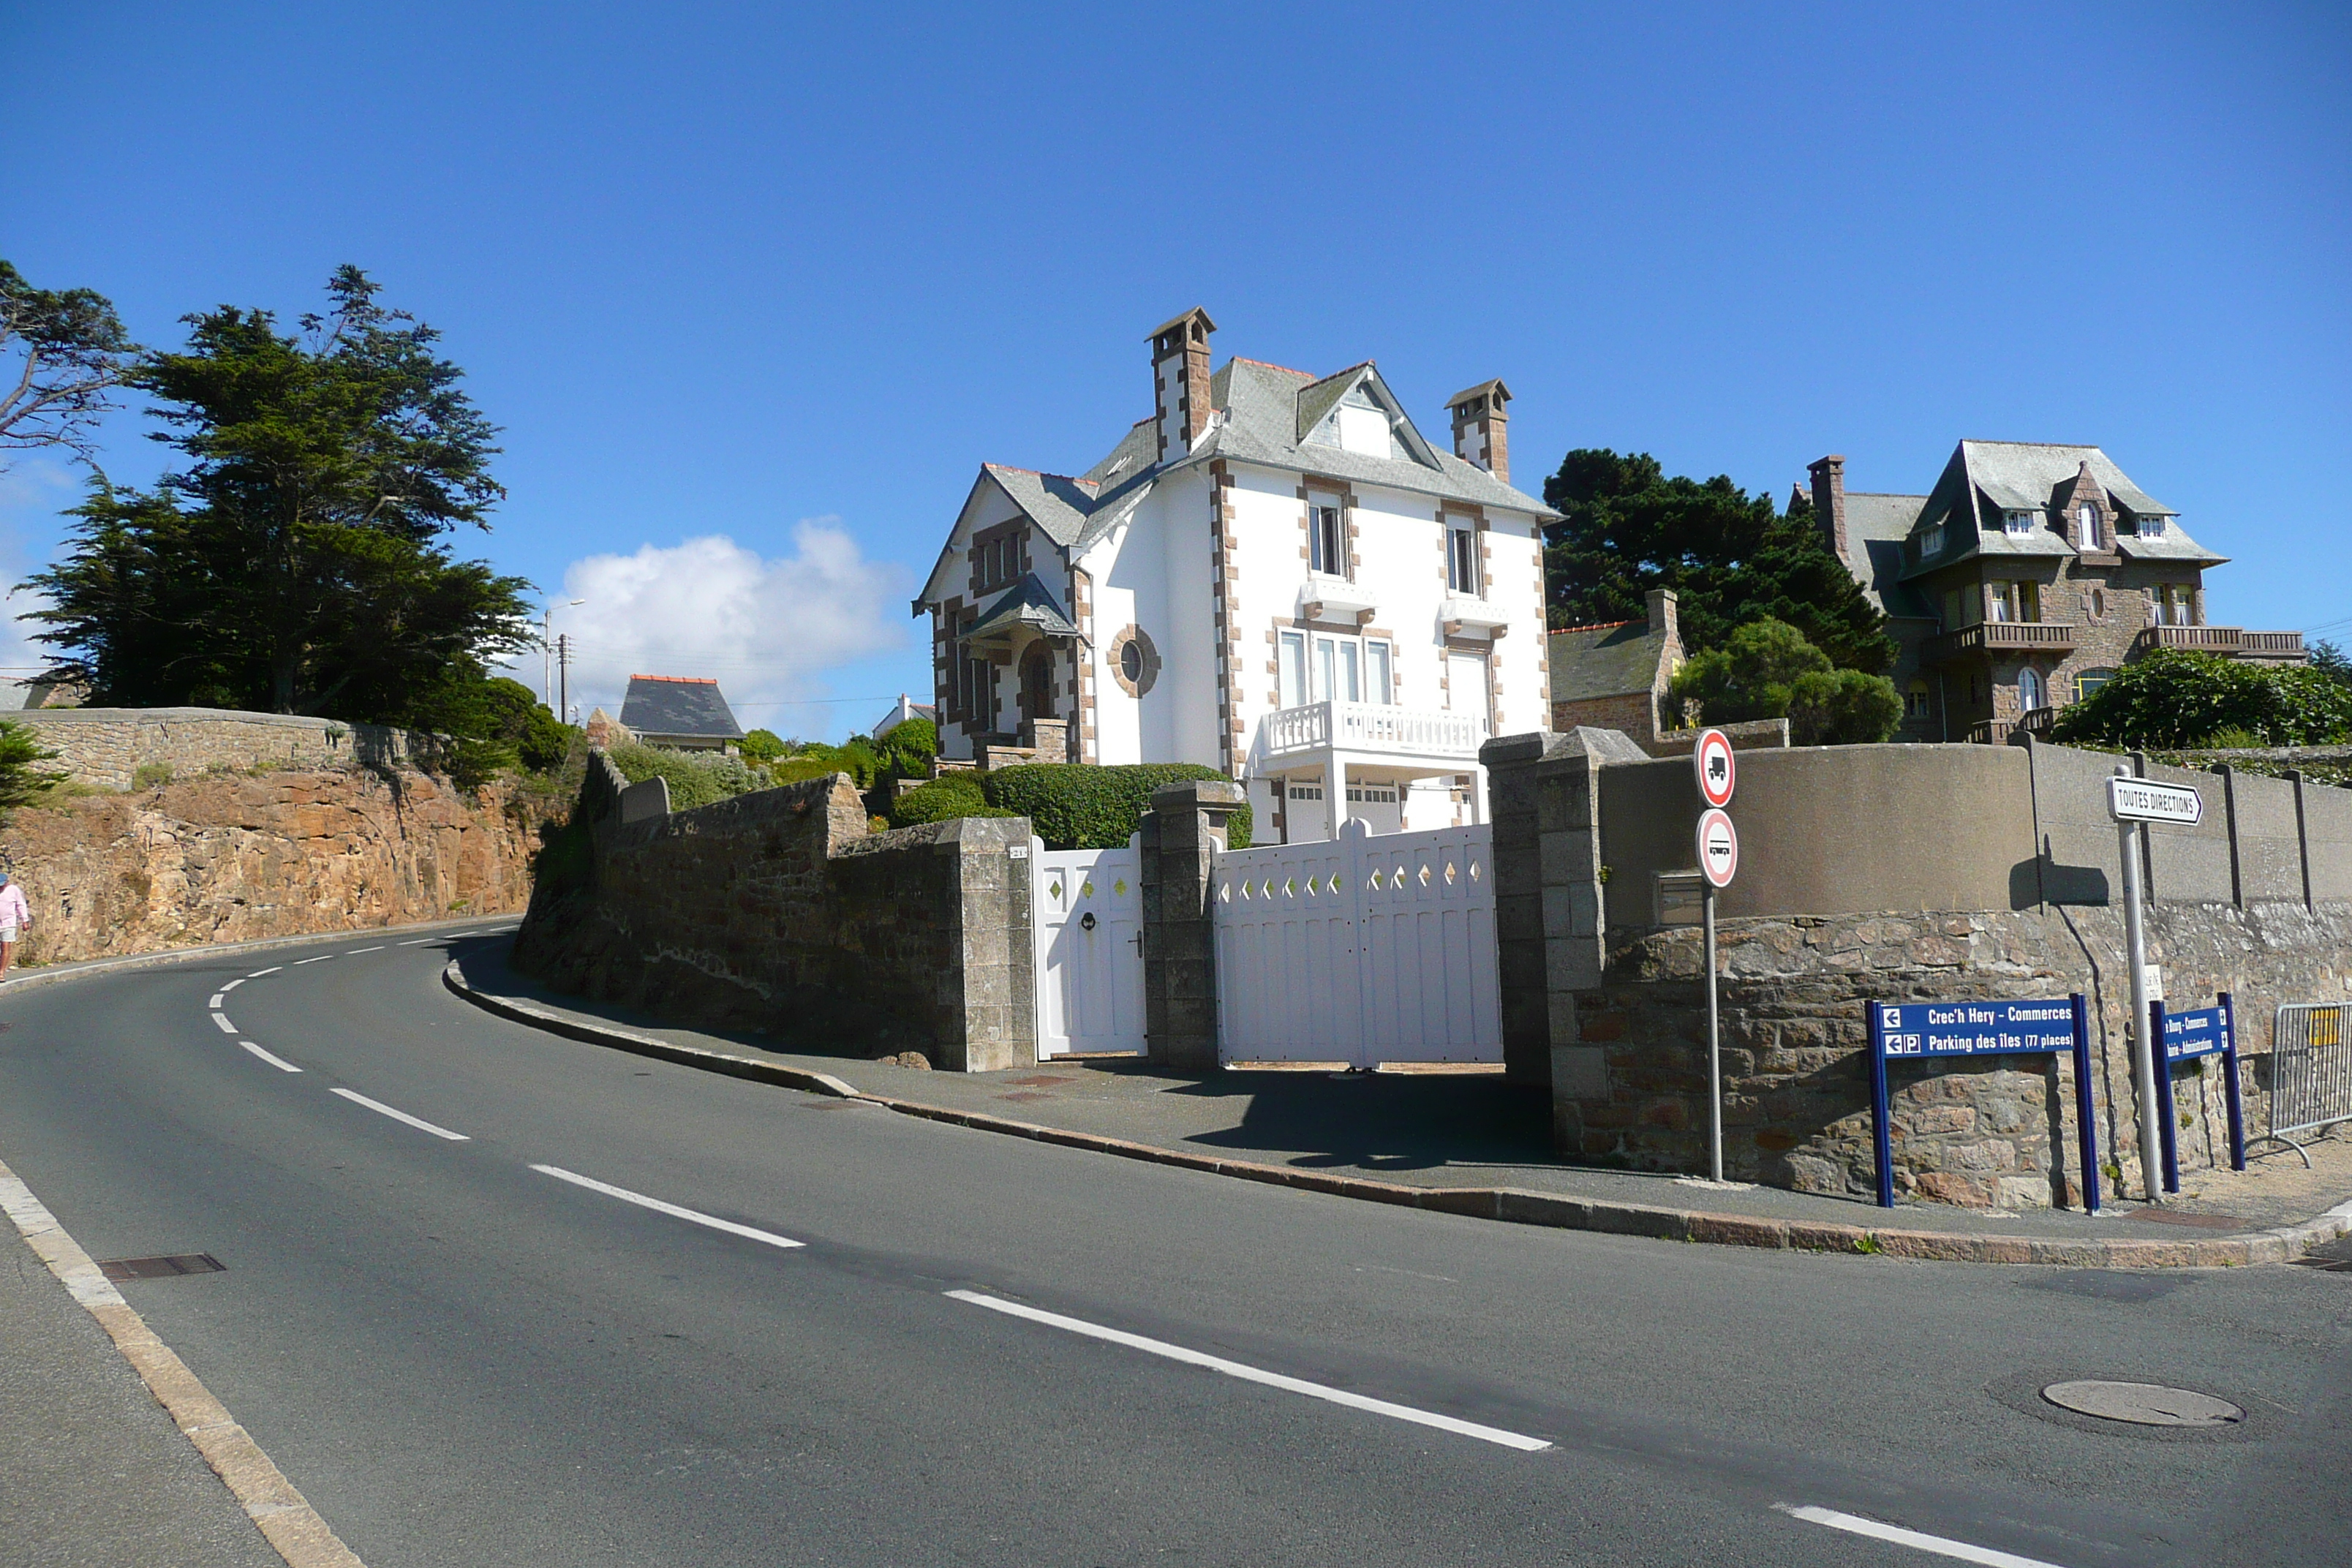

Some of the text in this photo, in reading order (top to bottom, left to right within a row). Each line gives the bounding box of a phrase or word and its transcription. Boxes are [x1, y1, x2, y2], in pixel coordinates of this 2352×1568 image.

[2118, 789, 2193, 814] TOUTES DIRECTIONS
[1929, 1009, 1965, 1024] Crec'h
[1968, 1007, 1994, 1025] Hery
[2008, 1006, 2072, 1021] Commerces
[2185, 1017, 2207, 1030] Commerces
[1907, 1037, 1917, 1051] P
[1929, 1035, 1972, 1052] Parking
[1976, 1033, 1997, 1049] des
[2000, 1033, 2021, 1048] îles
[2041, 1032, 2074, 1049] places)
